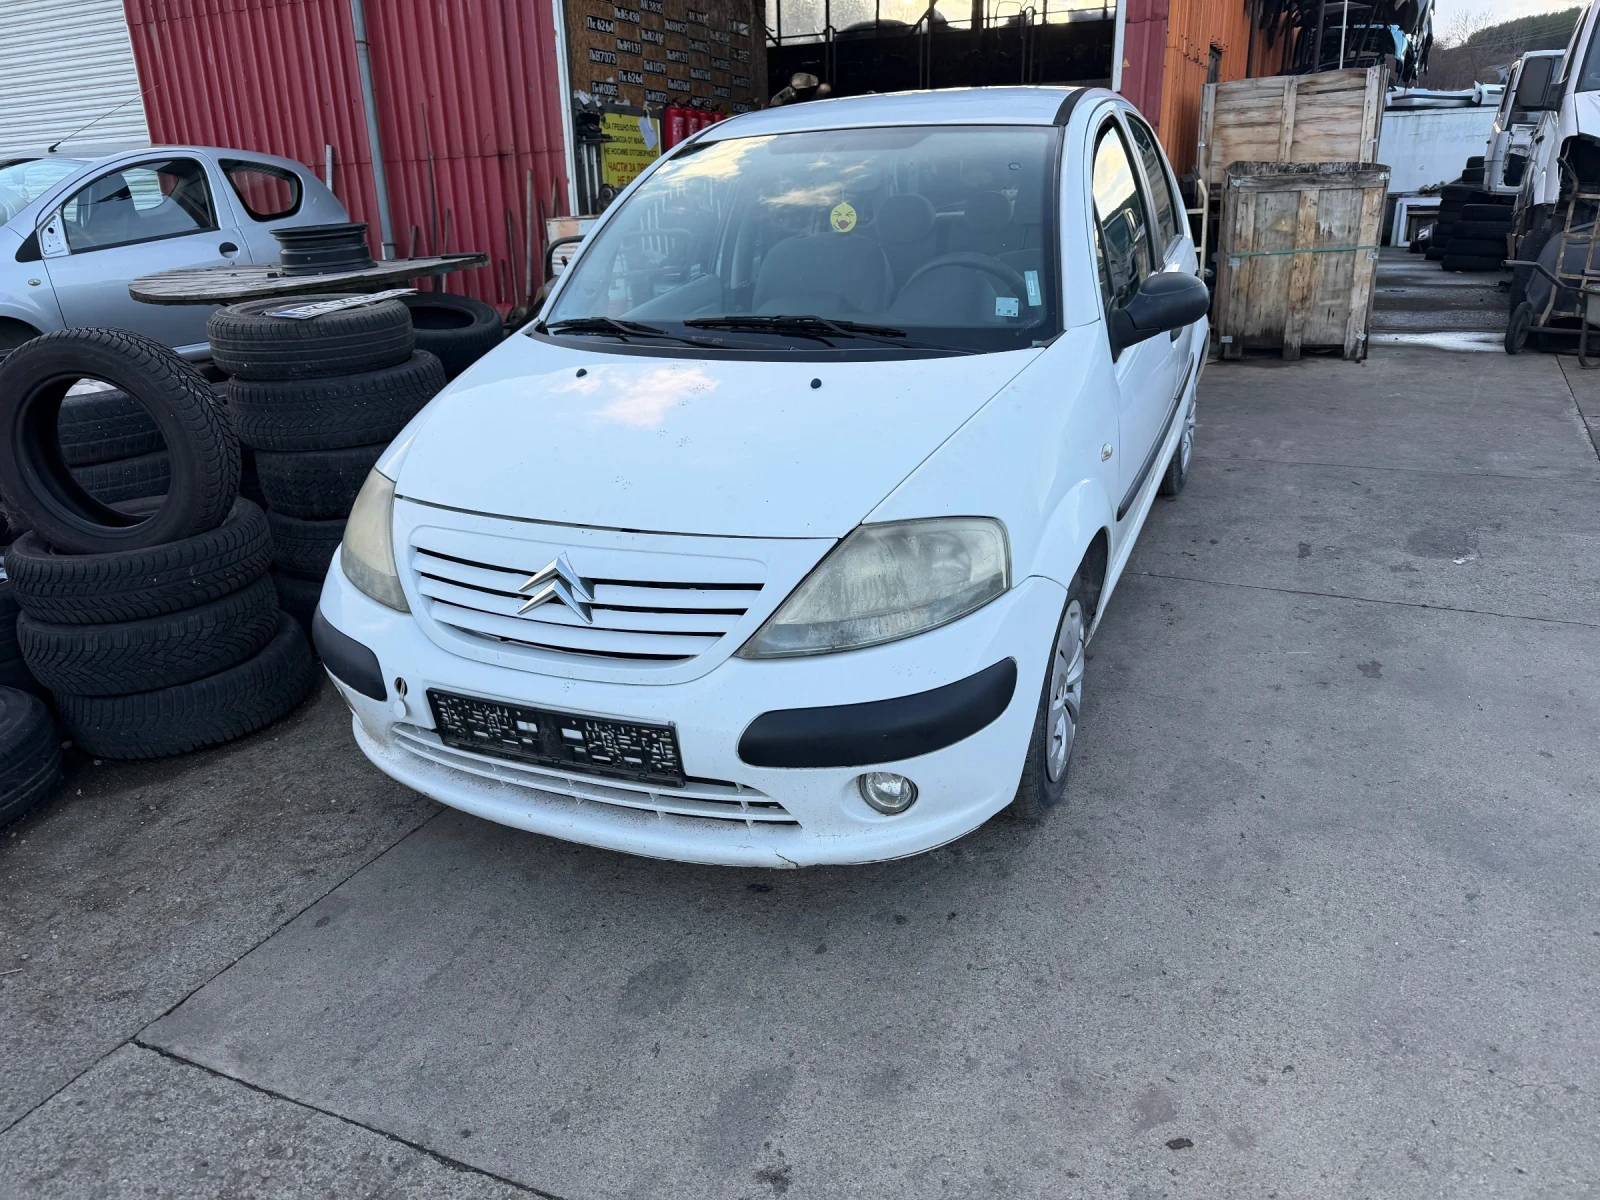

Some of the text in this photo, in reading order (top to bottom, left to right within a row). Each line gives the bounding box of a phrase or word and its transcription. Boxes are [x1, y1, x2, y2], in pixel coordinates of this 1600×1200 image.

[596, 19, 614, 33] 6264
[627, 72, 644, 84] 6264
[608, 162, 627, 173] ЧАСТИ
[628, 162, 637, 173] ЗА
[617, 175, 625, 185] НЕ
